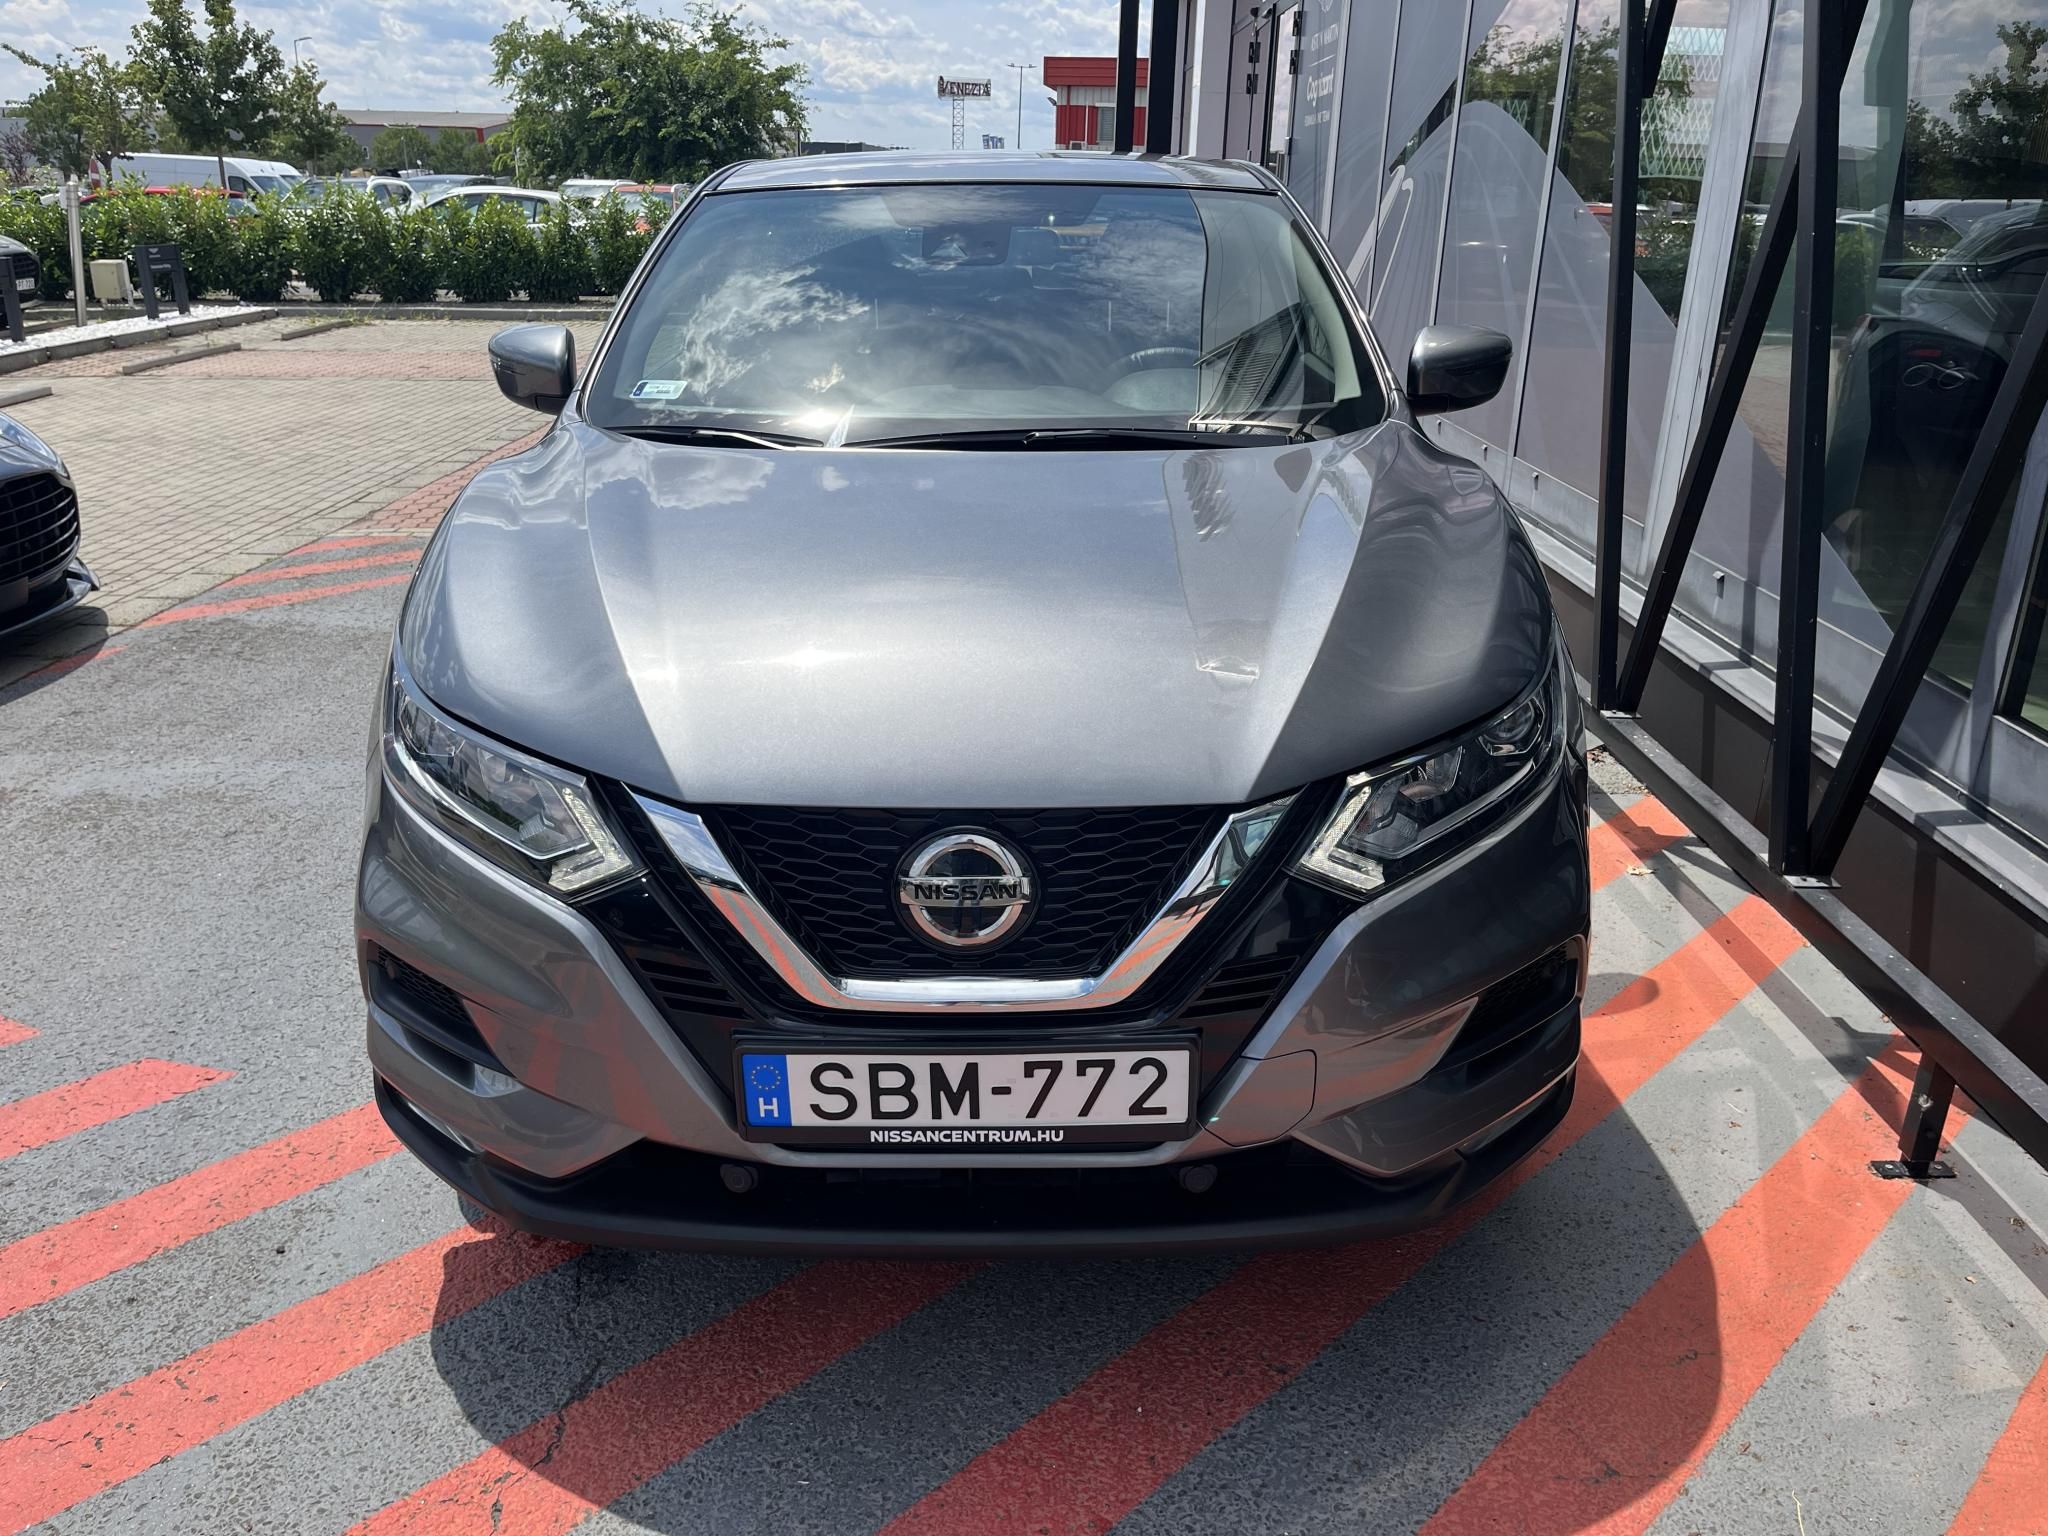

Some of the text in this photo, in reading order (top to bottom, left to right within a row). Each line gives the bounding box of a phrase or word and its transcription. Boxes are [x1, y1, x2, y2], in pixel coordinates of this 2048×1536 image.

[914, 884, 1018, 900] NISSAN
[758, 1057, 1168, 1121] H SBM-772
[870, 1130, 1064, 1143] NISSANCENTRUM.HU
